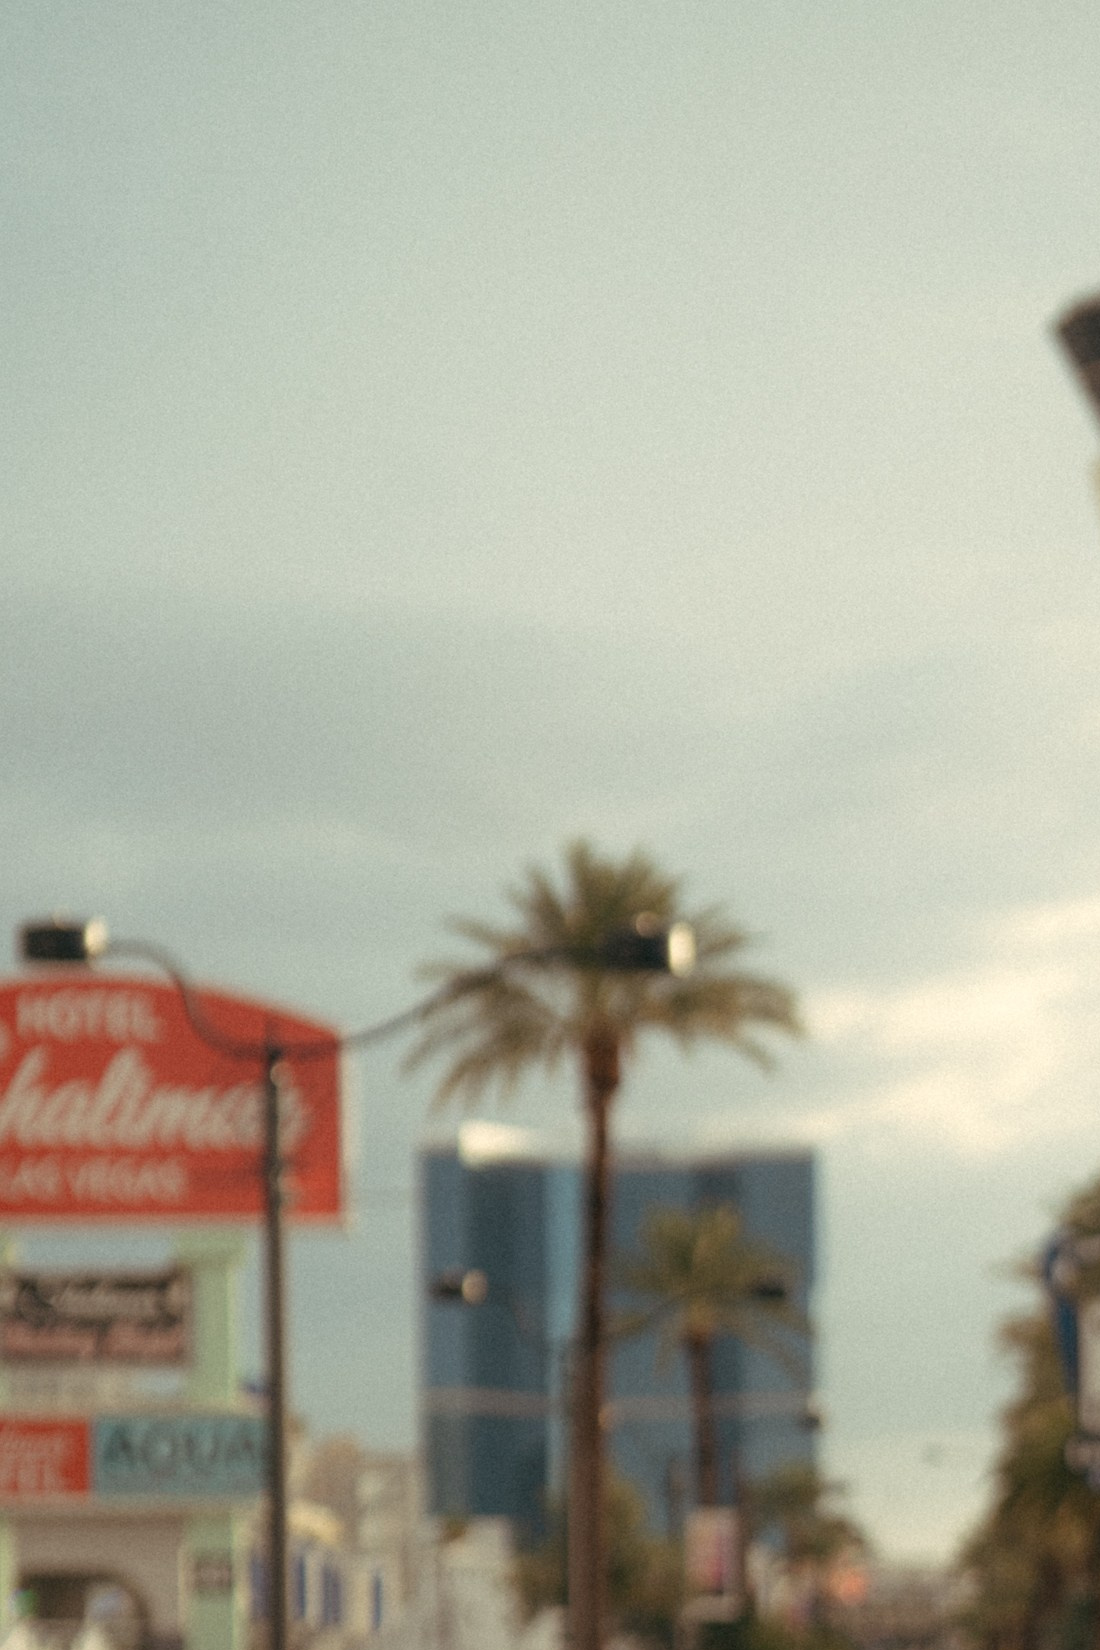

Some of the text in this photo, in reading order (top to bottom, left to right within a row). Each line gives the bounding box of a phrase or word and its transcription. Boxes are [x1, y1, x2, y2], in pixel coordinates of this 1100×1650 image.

[15, 987, 162, 1044] HOTEL
[0, 1030, 313, 1152] halimar
[67, 1156, 188, 1205] VEGAS
